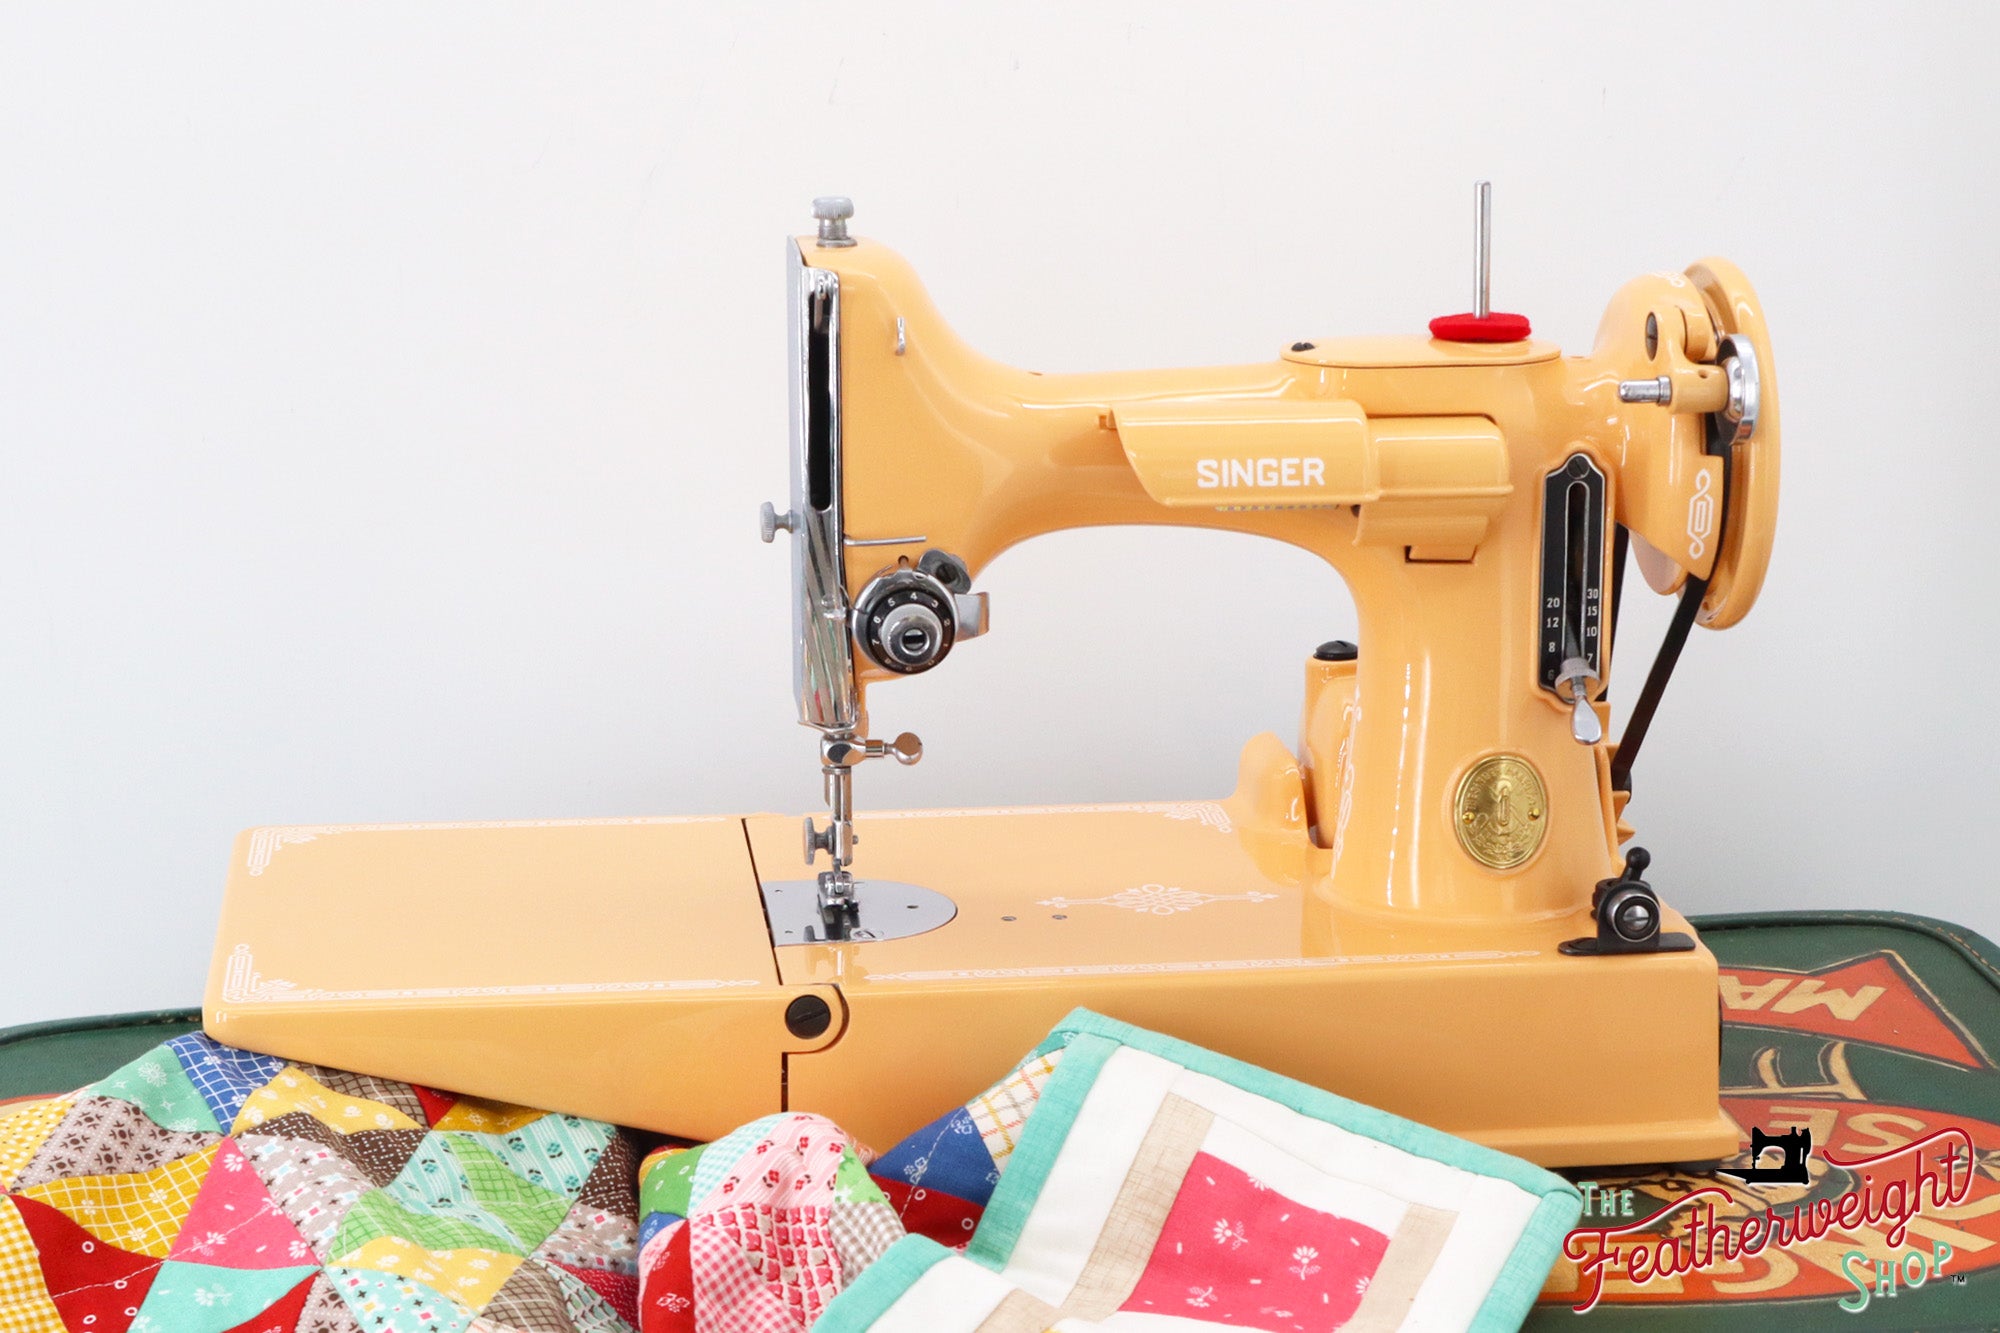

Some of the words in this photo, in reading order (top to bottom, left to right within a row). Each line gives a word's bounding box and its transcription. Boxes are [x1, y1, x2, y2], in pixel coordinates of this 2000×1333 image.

[1196, 457, 1325, 488] SINGER
[910, 592, 918, 601] 4
[1587, 588, 1599, 599] 30
[888, 598, 896, 607] 5
[1546, 597, 1560, 608] 20
[1587, 606, 1598, 616] 15
[1546, 617, 1559, 628] 12
[1586, 626, 1598, 637] 10
[1548, 642, 1556, 653] 8
[1587, 653, 1594, 663] 7
